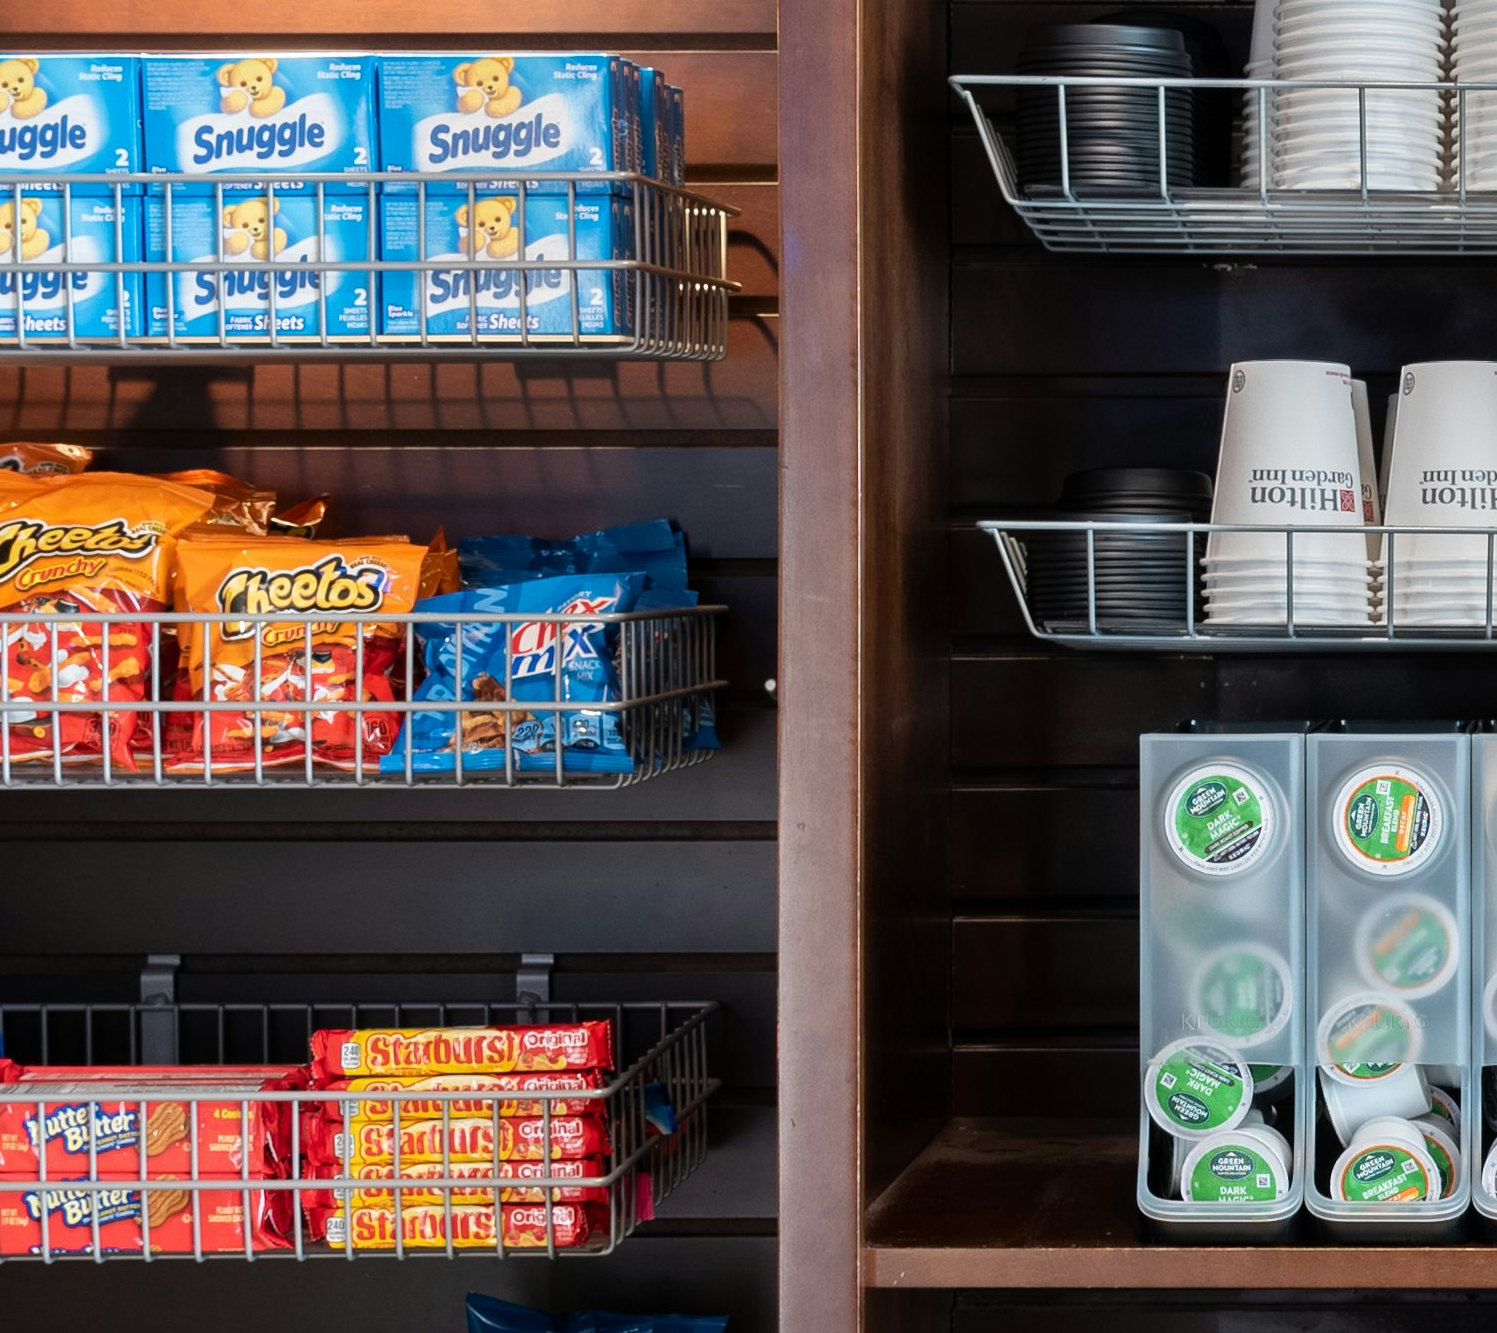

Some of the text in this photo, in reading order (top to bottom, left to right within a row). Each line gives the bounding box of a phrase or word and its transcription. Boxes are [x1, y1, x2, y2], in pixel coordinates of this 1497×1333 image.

[79, 72, 122, 82] Static Cling
[90, 64, 123, 74] Reduces
[317, 70, 361, 81] Static Cling
[329, 63, 361, 72] Reduces
[193, 113, 325, 164] Snuggle
[428, 113, 561, 164] Snuggle
[115, 149, 129, 166] 2
[354, 147, 367, 164] 2
[1252, 469, 1353, 488] Garden Inn
[1423, 470, 1455, 484] Inn
[1251, 486, 1339, 511] Hilton
[15, 555, 108, 592] Crunchy
[219, 556, 384, 642] Cheetos
[1190, 789, 1225, 814] MOUNTAIN
[1192, 787, 1216, 805] GREEN
[1207, 811, 1232, 830] DARK
[1356, 803, 1364, 830] GREEN
[1361, 797, 1372, 837] MOUNTAIN
[1381, 796, 1394, 844] BREAKFAST
[1391, 810, 1399, 832] BLEND
[1210, 818, 1240, 840] MAGIC
[366, 1030, 588, 1066] Starburst Original
[1212, 1164, 1252, 1172] MOUNTAIN
[1220, 1187, 1246, 1195] DARK
[1362, 1175, 1407, 1199] BREAKFAST
